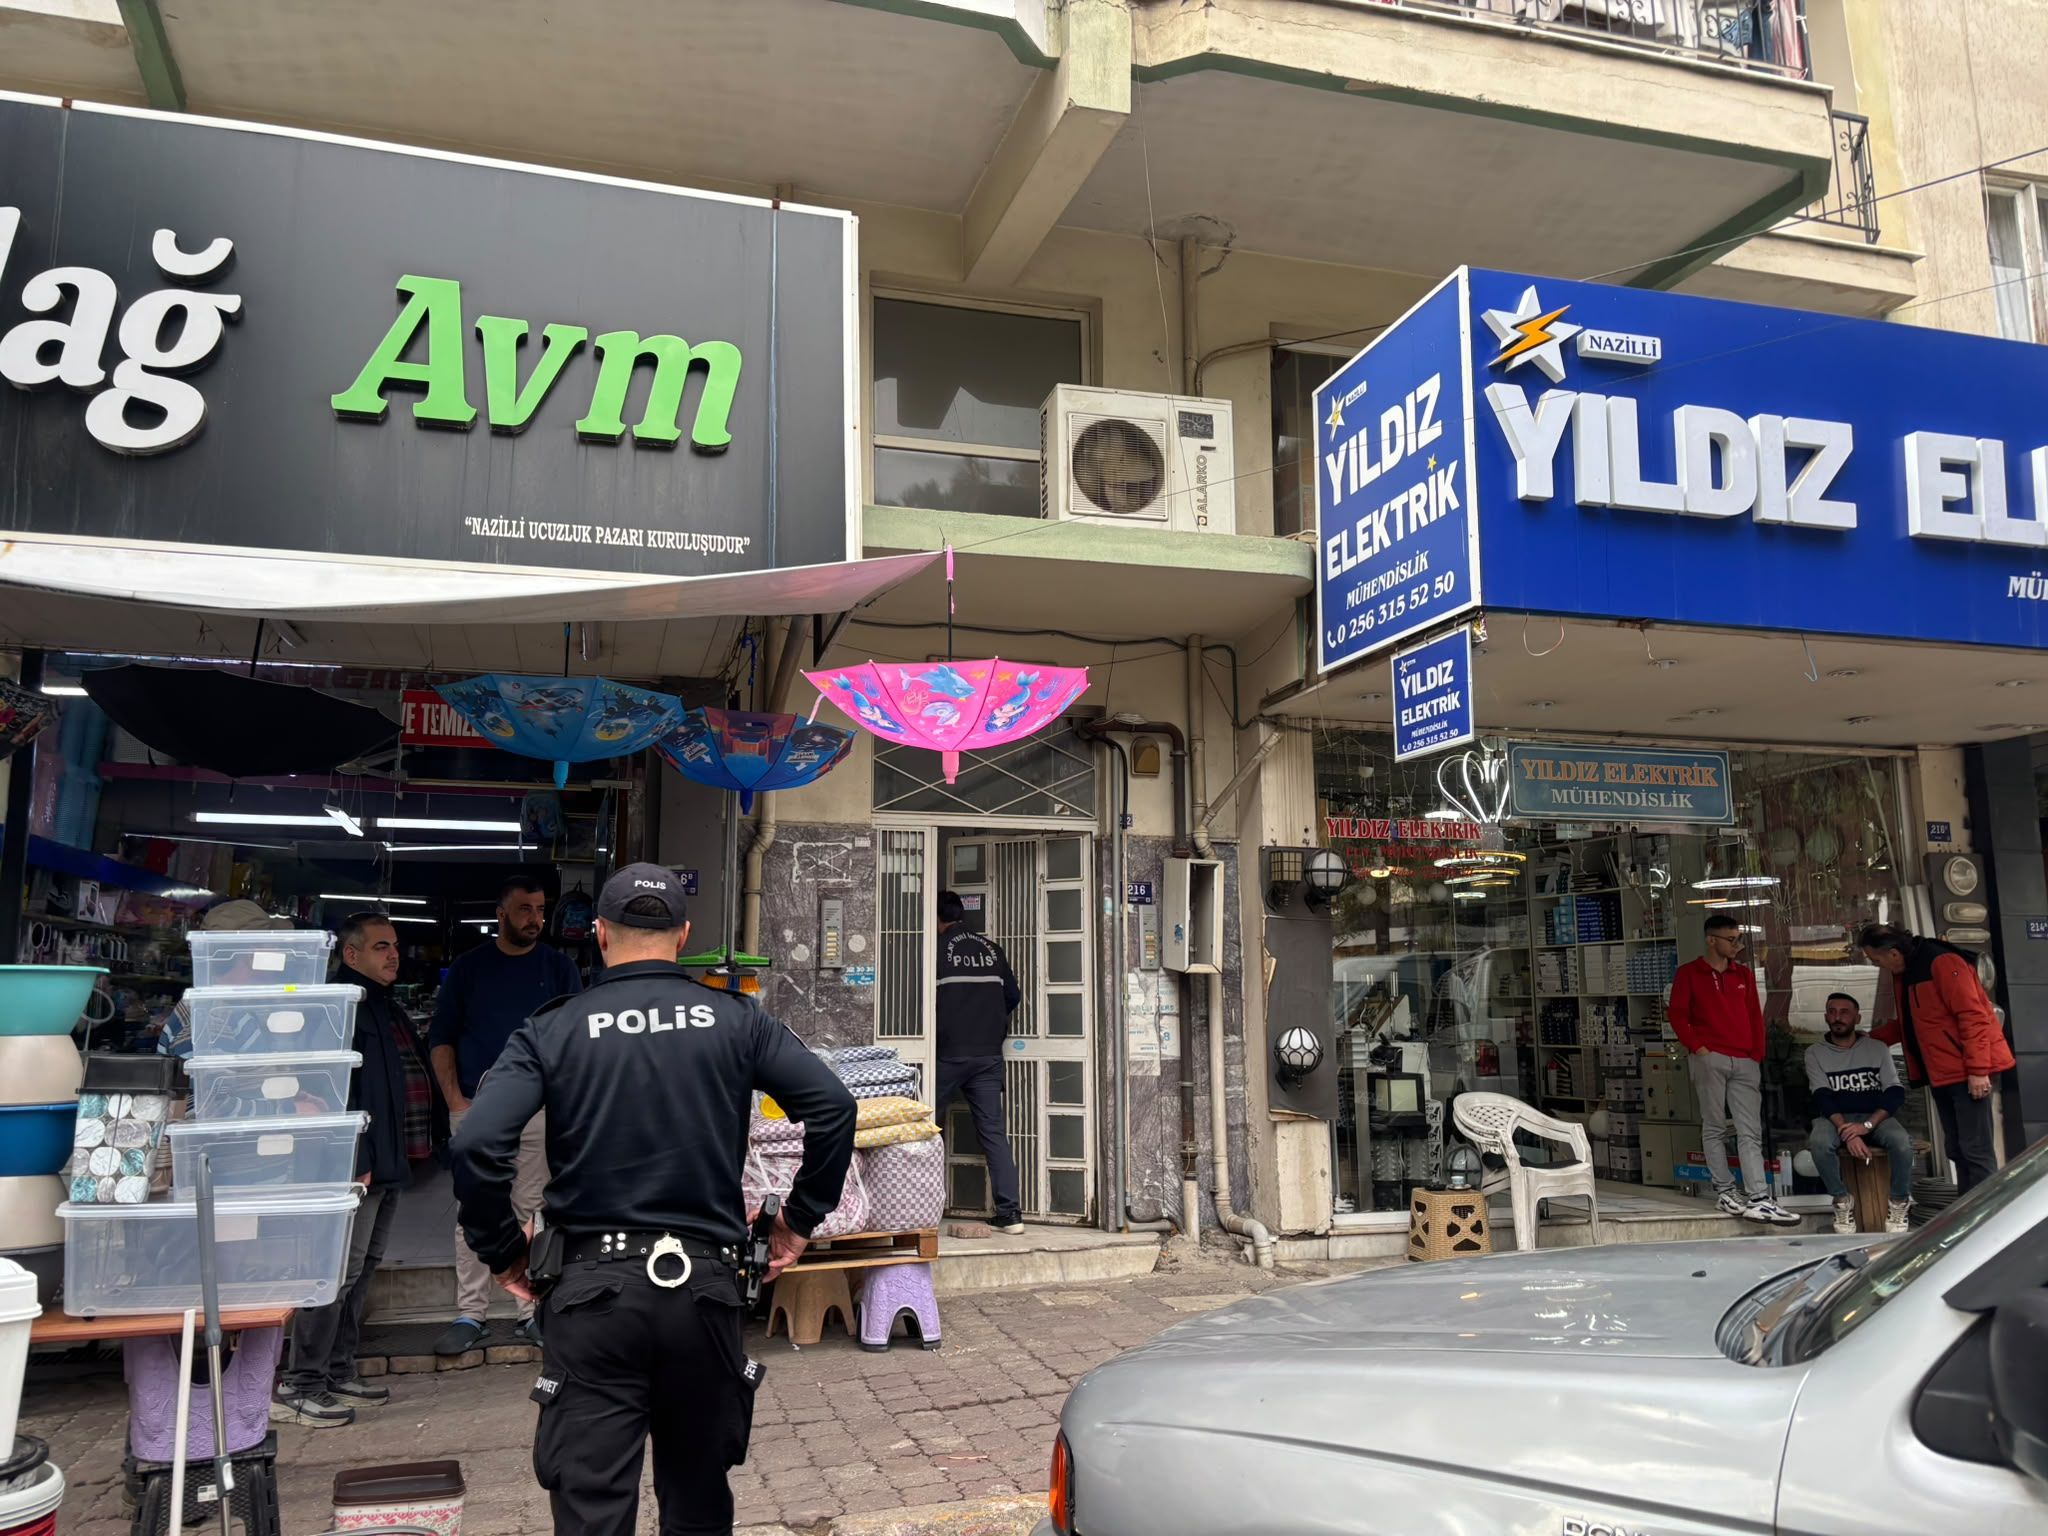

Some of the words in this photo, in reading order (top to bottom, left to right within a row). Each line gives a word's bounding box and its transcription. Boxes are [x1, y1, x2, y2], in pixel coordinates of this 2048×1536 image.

[0, 206, 241, 450] ağ
[331, 274, 742, 452] Avm
[1589, 335, 1657, 357] NAZİLLİ
[1325, 372, 1442, 506] YILDIZ
[1196, 454, 1208, 514] ALARKO
[1484, 382, 1857, 529] YILDIZ
[1904, 431, 2048, 549] EL
[529, 521, 592, 544] UCUZLUK
[595, 526, 644, 547] PAZARI
[1326, 456, 1460, 581] ELEKTRİK
[1346, 550, 1429, 610] MÜHENDİSLİK
[1337, 624, 1346, 644] 0
[1349, 610, 1374, 639] 256
[1377, 594, 1405, 625] 315
[1409, 583, 1429, 610] 52
[1433, 570, 1455, 599] 50
[1400, 659, 1454, 699] YILDIZ
[1401, 688, 1461, 727] ELEKTRİK
[1412, 738, 1425, 750] 256
[1425, 733, 1438, 745] 315
[1439, 731, 1448, 743] 52
[1449, 728, 1459, 738] 50
[1520, 758, 1598, 782] YILDIZ
[1603, 762, 1718, 787] ELEKTRİK
[1551, 786, 1694, 808] MÜHENDİSLİK
[1324, 817, 1391, 839] YILDIZ
[1397, 817, 1482, 840] ELEKTRİK
[1128, 884, 1146, 895] 216
[953, 951, 994, 968] POLİS
